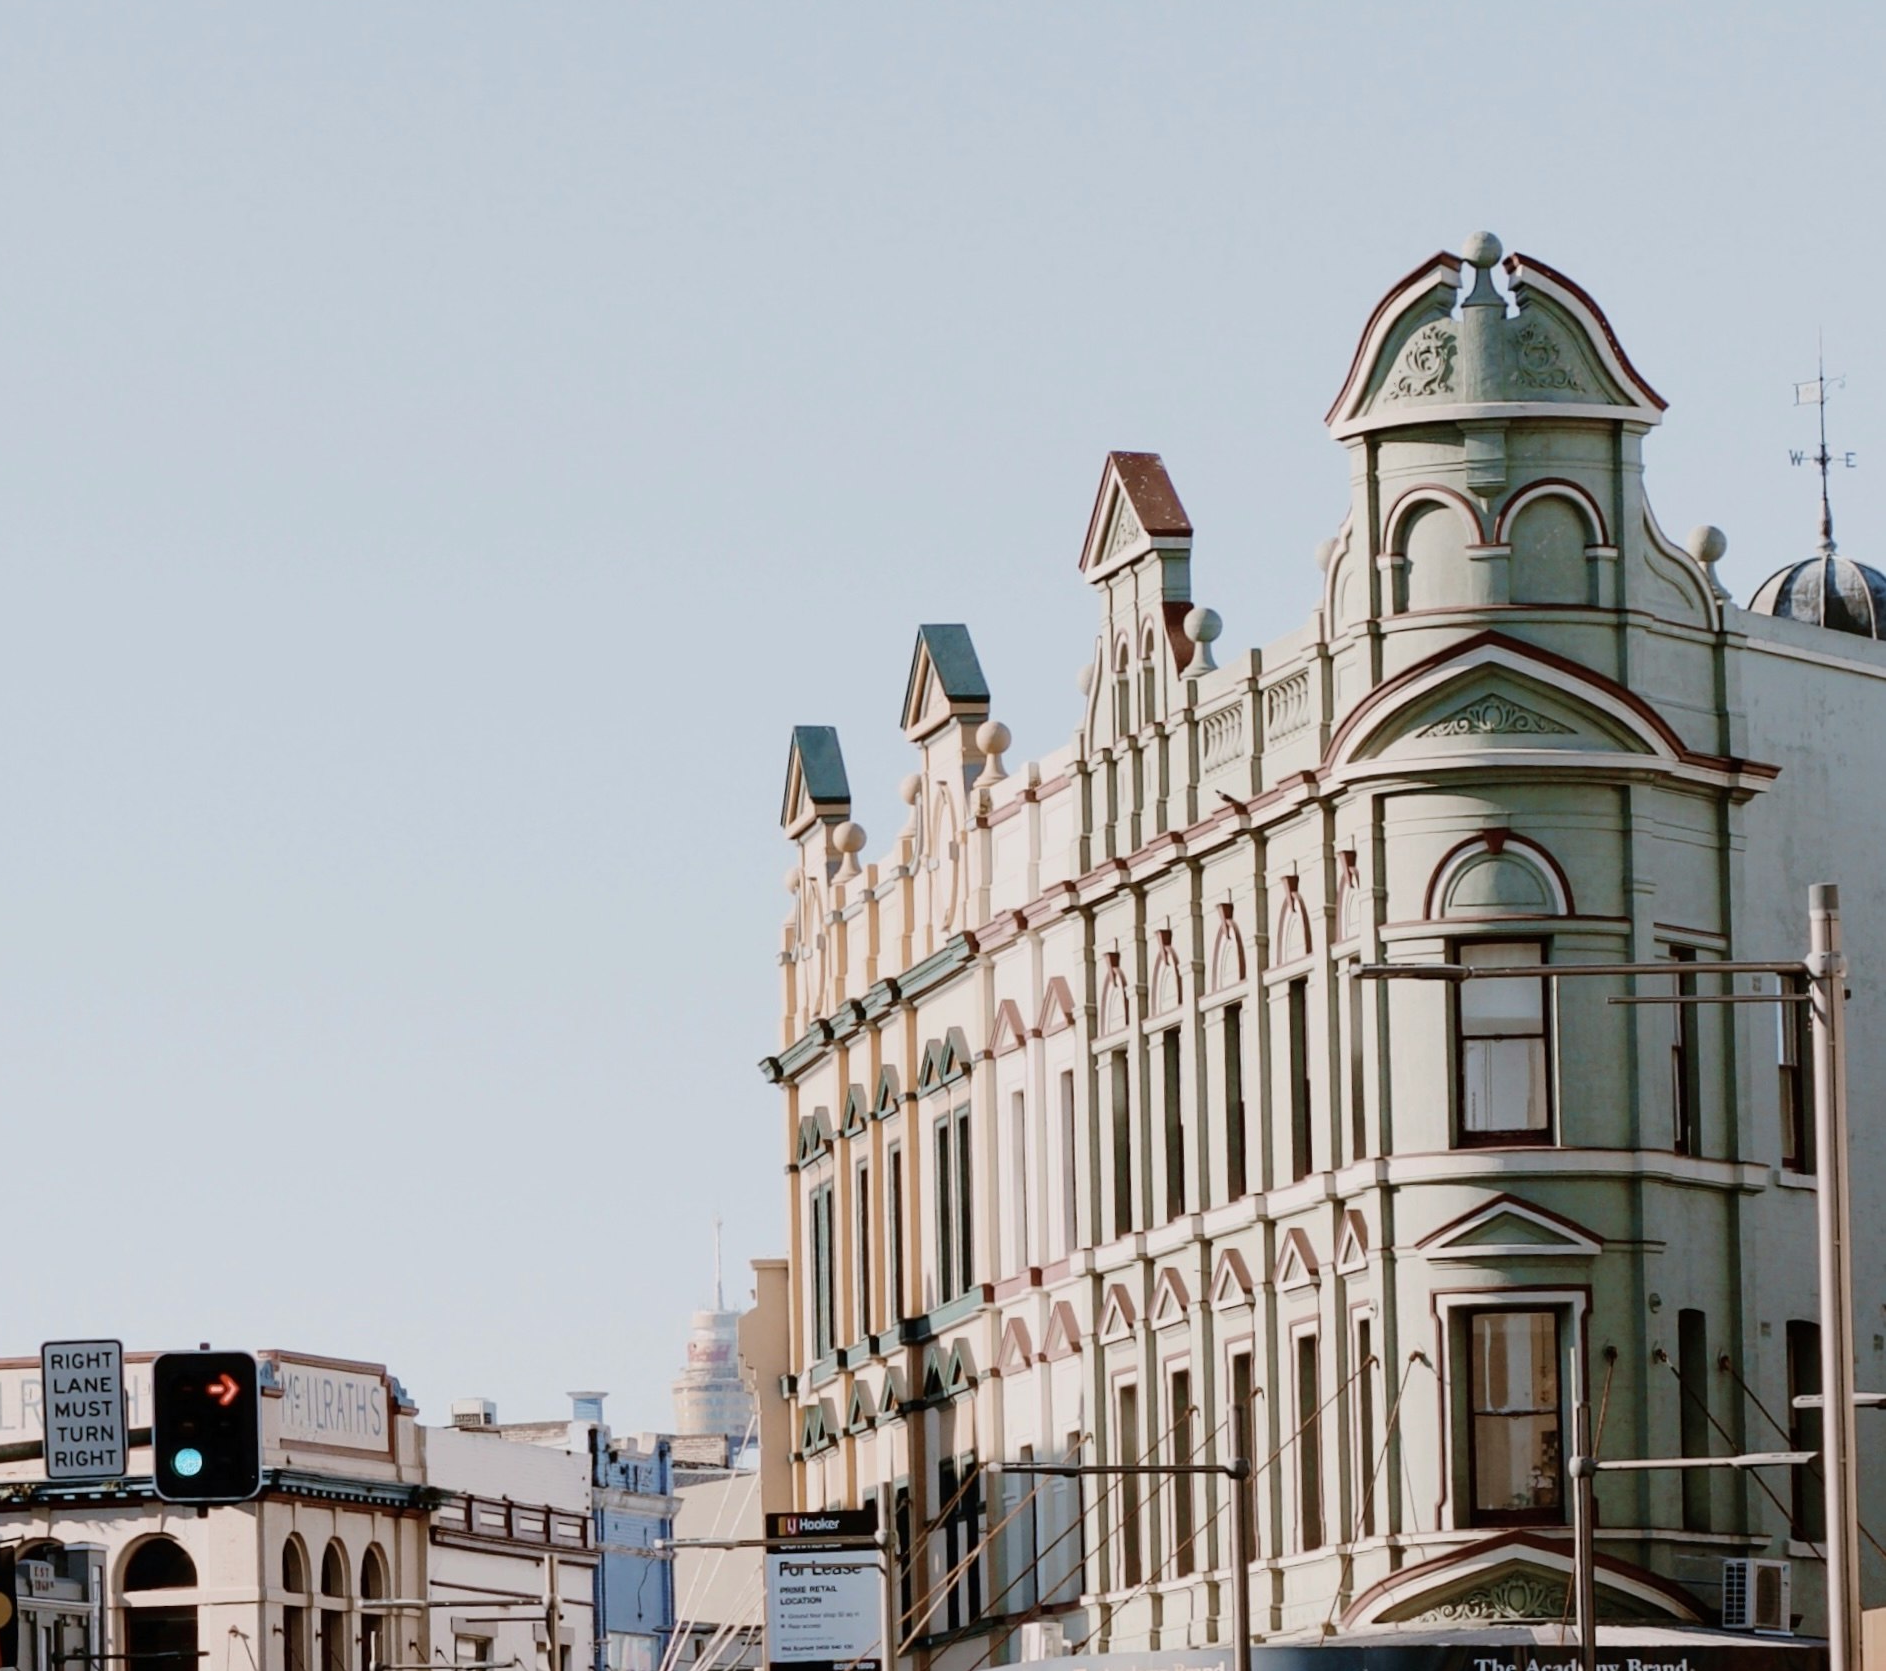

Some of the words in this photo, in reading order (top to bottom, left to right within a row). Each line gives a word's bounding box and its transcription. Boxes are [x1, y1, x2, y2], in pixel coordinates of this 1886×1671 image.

[1789, 450, 1804, 467] W
[1846, 452, 1857, 468] E
[51, 1352, 112, 1369] RIGHT
[54, 1377, 112, 1394] LANE
[55, 1401, 113, 1418] MUST
[56, 1425, 114, 1442] TURN
[55, 1450, 117, 1468] RIGHT
[799, 1516, 841, 1532] Hooker
[779, 1561, 804, 1577] For
[812, 1560, 862, 1576] Lease
[780, 1586, 806, 1594] PRIME
[810, 1585, 837, 1593] RETAIL
[780, 1597, 822, 1605] LOCATION
